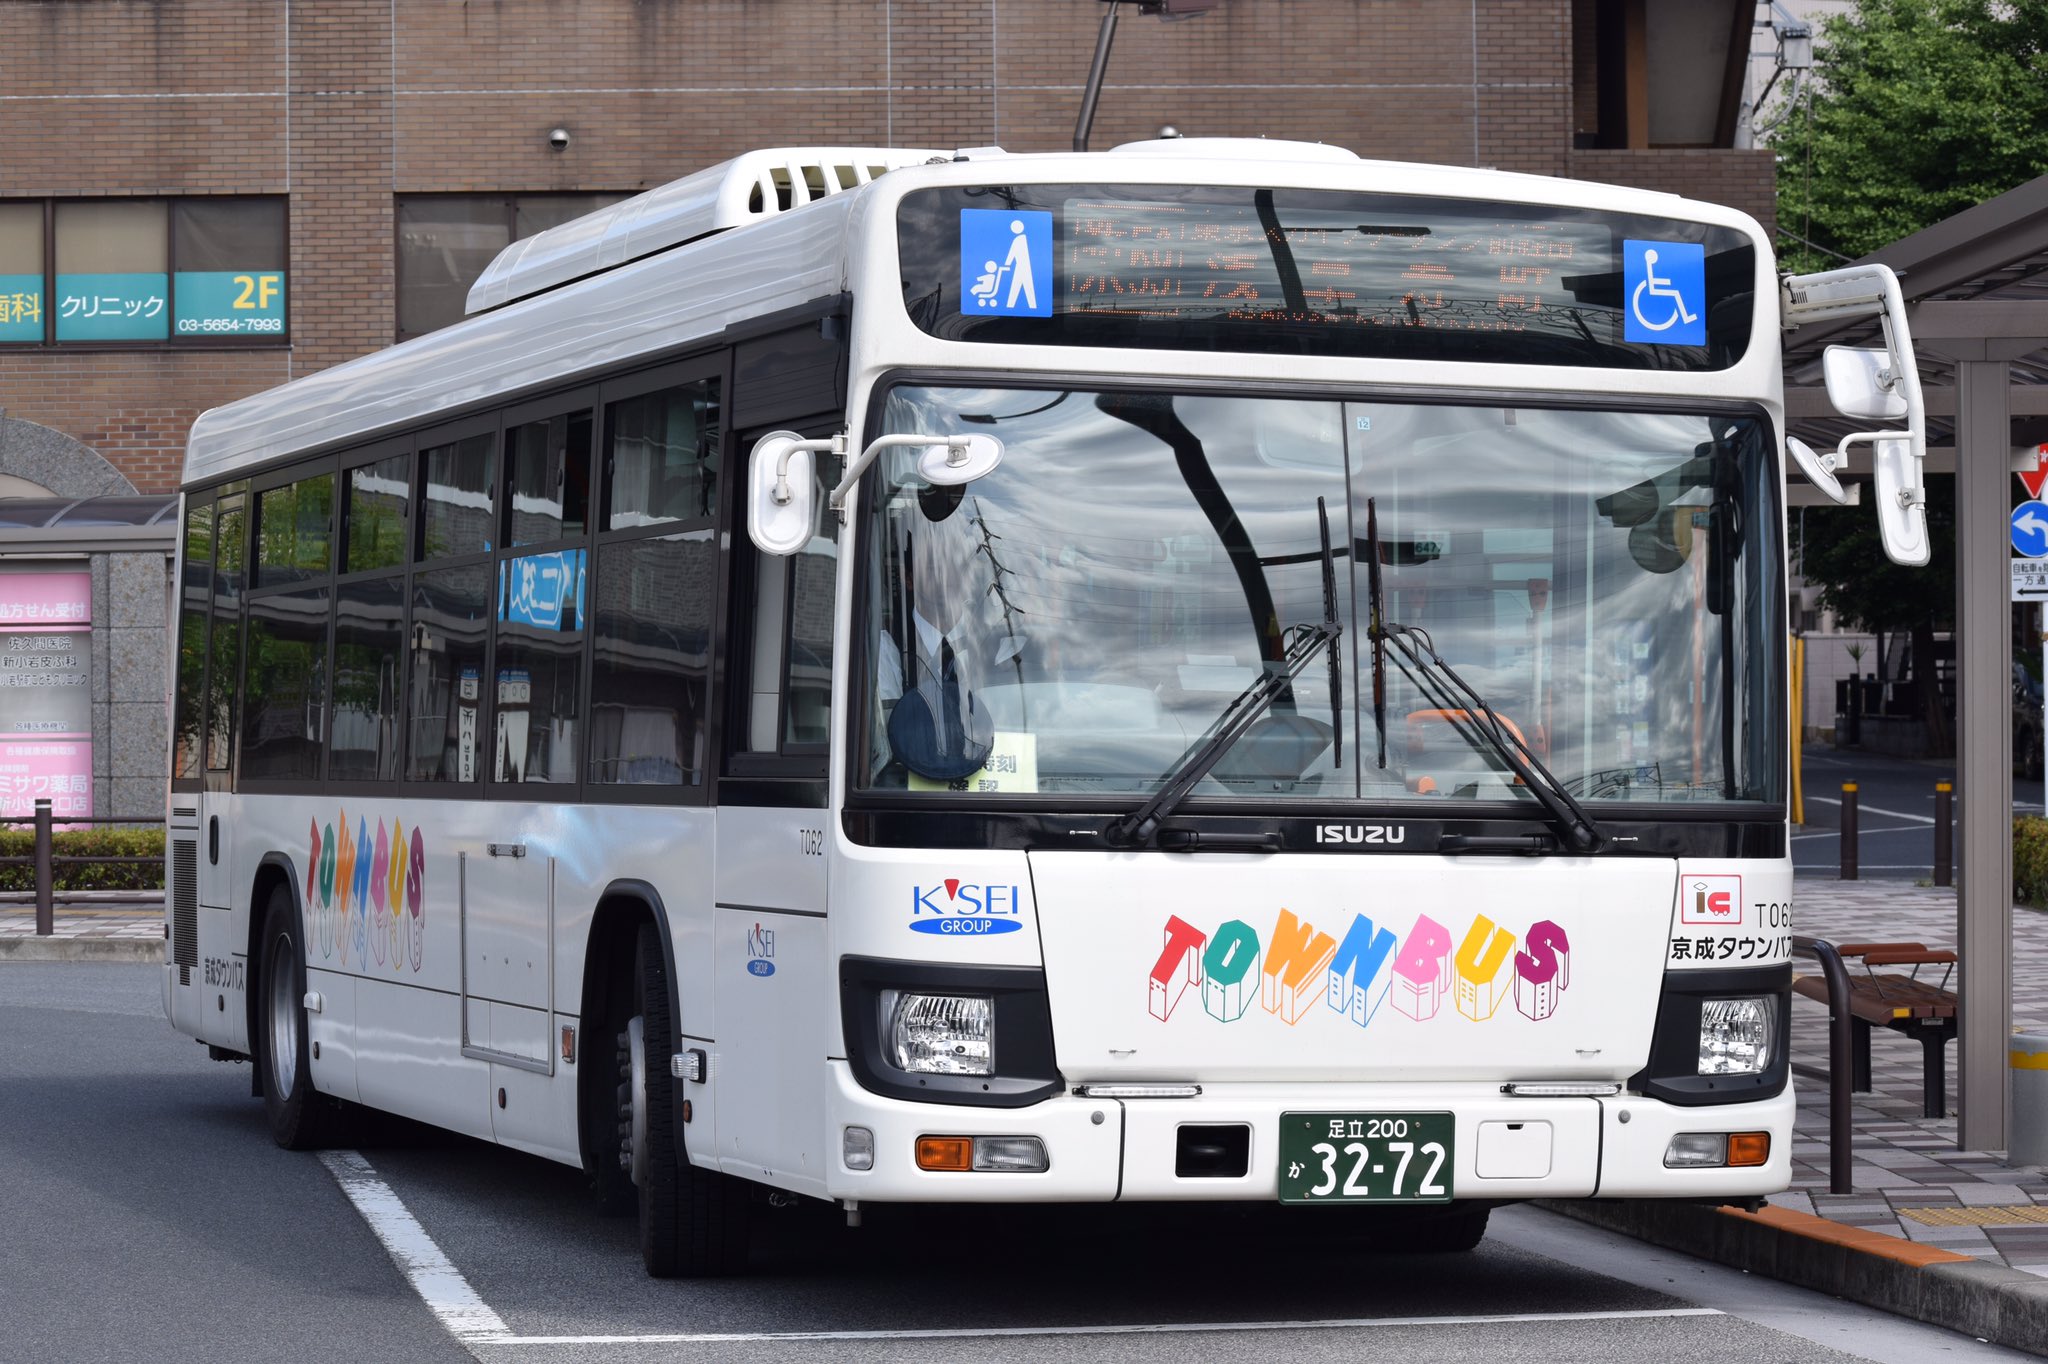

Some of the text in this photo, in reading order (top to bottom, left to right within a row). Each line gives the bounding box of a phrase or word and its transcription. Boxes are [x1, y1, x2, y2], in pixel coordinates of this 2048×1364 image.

[232, 275, 279, 309] 2F
[61, 295, 164, 318] クリニック
[178, 318, 281, 332] 03-5654-7993
[800, 829, 823, 856] T062
[1316, 825, 1405, 843] ISUZU
[940, 919, 992, 933] GROUP
[753, 961, 768, 974] GROUP
[1149, 907, 1570, 1028] TOWNBUS
[1288, 1142, 1446, 1196] か 32-72
